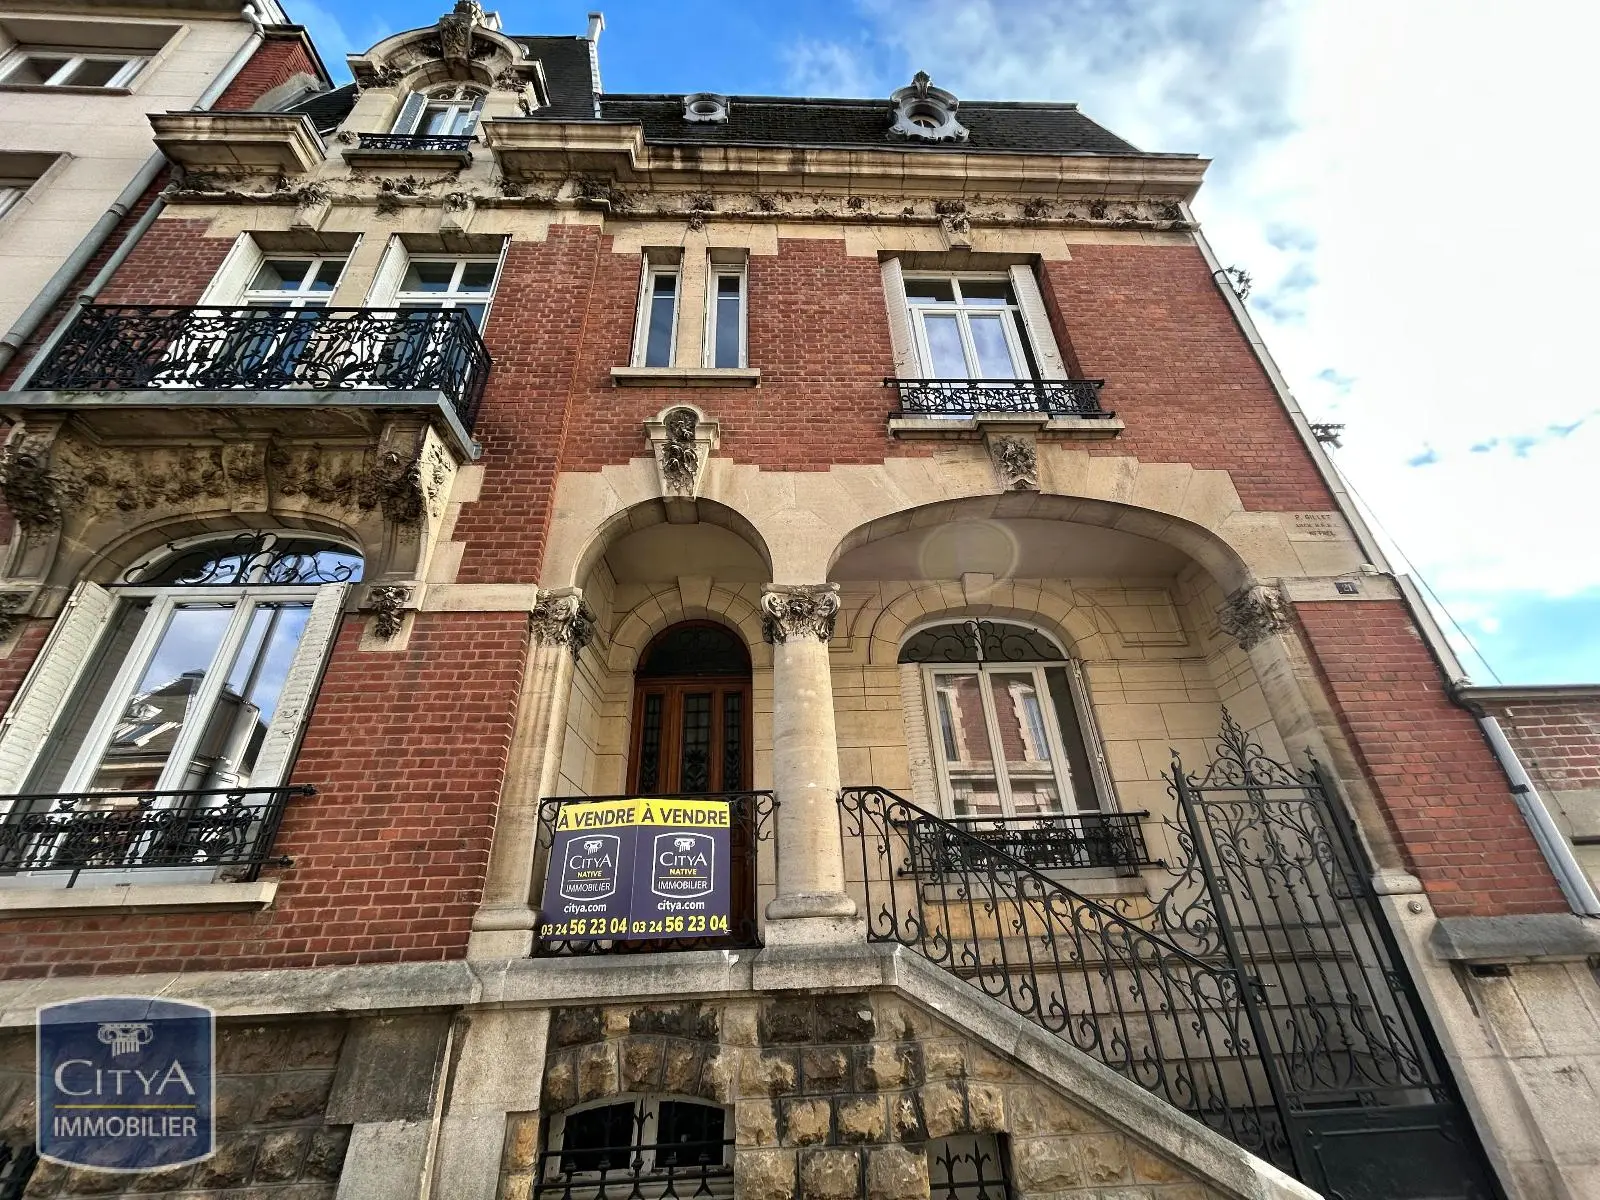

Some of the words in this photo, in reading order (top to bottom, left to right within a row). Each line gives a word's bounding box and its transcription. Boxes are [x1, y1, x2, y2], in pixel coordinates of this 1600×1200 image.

[558, 808, 569, 828] À
[575, 808, 635, 827] VENDRE
[641, 803, 654, 822] À
[660, 808, 727, 825] VENDRE
[577, 870, 602, 878] NATIVE
[565, 882, 611, 892] IMMOBILIER
[658, 880, 707, 889] IMMOBILIER
[563, 903, 607, 914] citya.com
[657, 900, 705, 912] citya.com
[541, 924, 553, 936] 03
[555, 923, 567, 935] 24
[569, 918, 587, 935] 56
[589, 917, 607, 934] 23
[610, 917, 628, 934] 04
[632, 921, 647, 933] 03
[648, 920, 663, 933] 24
[665, 915, 684, 932] 56
[687, 915, 706, 932] 23
[709, 914, 727, 931] 04
